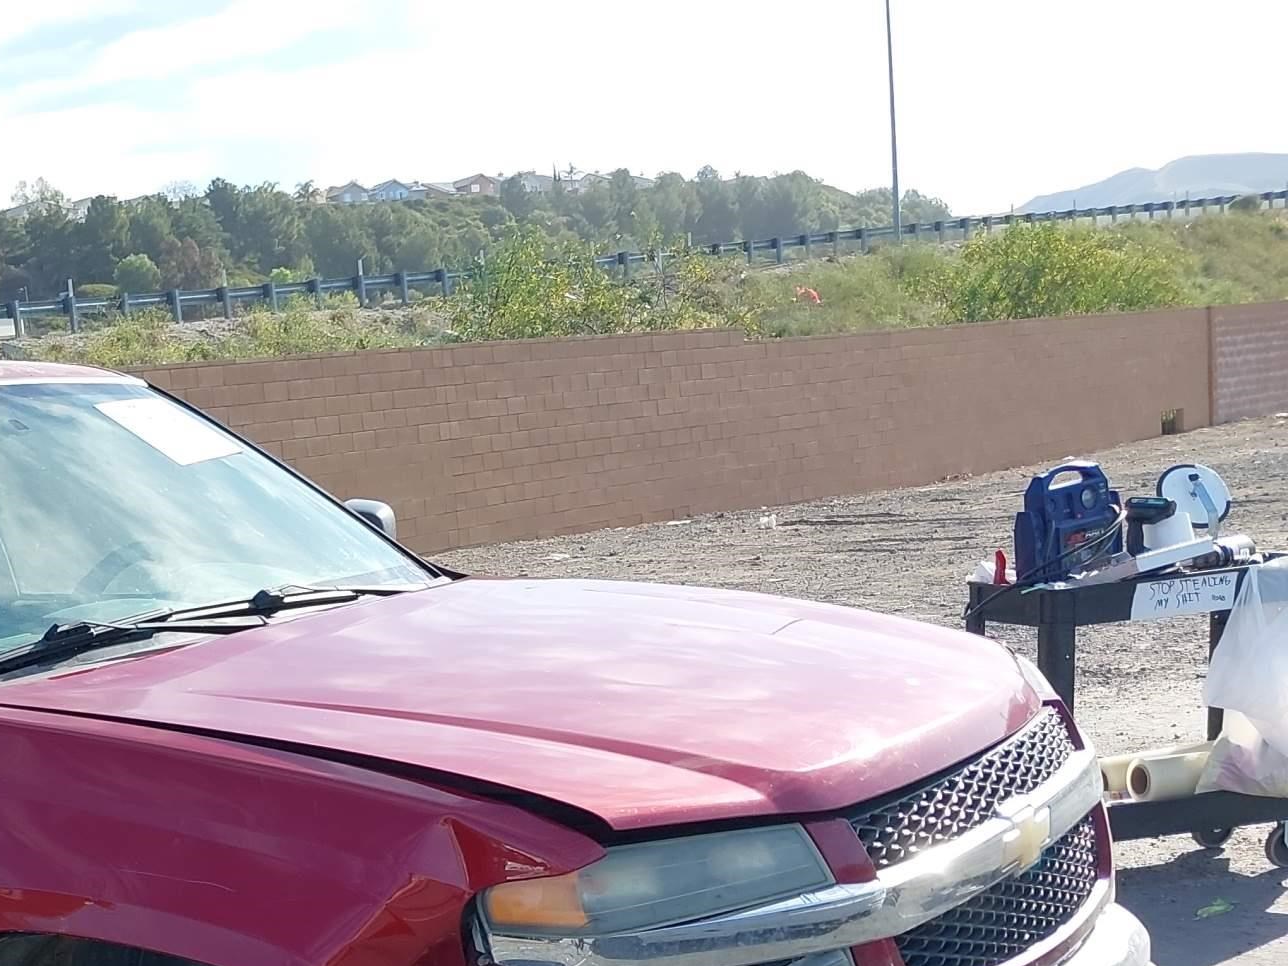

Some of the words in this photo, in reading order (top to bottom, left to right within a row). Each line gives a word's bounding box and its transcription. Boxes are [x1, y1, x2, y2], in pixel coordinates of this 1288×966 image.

[1150, 581, 1176, 600] STOP
[1177, 576, 1232, 594] STEALING
[1154, 597, 1169, 611] MY
[1176, 592, 1201, 608] SHIT
